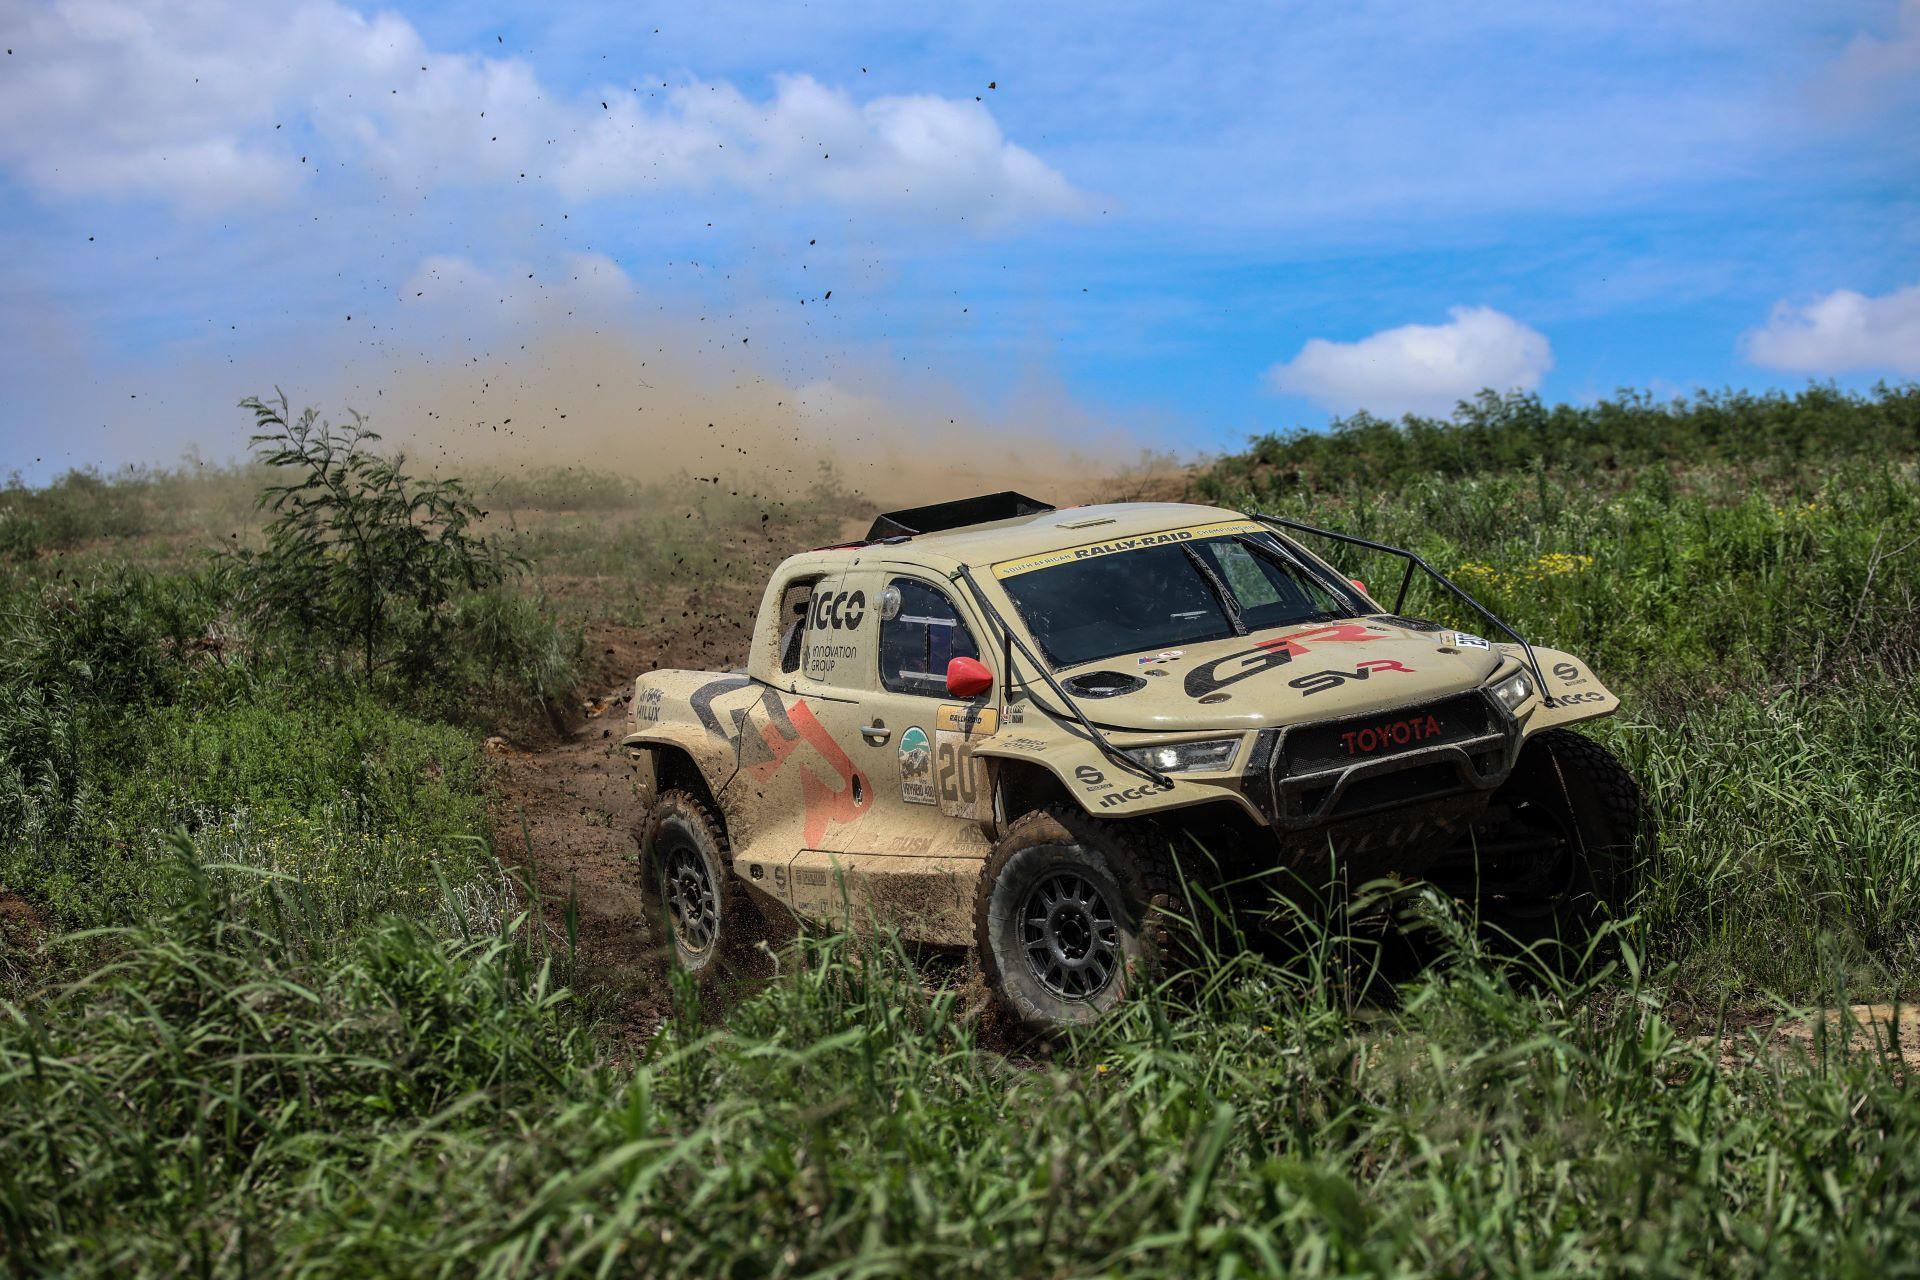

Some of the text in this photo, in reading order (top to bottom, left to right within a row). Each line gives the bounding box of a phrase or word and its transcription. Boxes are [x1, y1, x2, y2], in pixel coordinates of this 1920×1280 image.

[1074, 531, 1193, 559] RALLY-RAID
[811, 660, 836, 672] GROUP
[1288, 659, 1416, 697] SVR
[637, 705, 661, 722] HILUX
[1341, 714, 1442, 755] TOYOTA
[938, 742, 977, 804] 20
[1099, 784, 1173, 808] INGC
